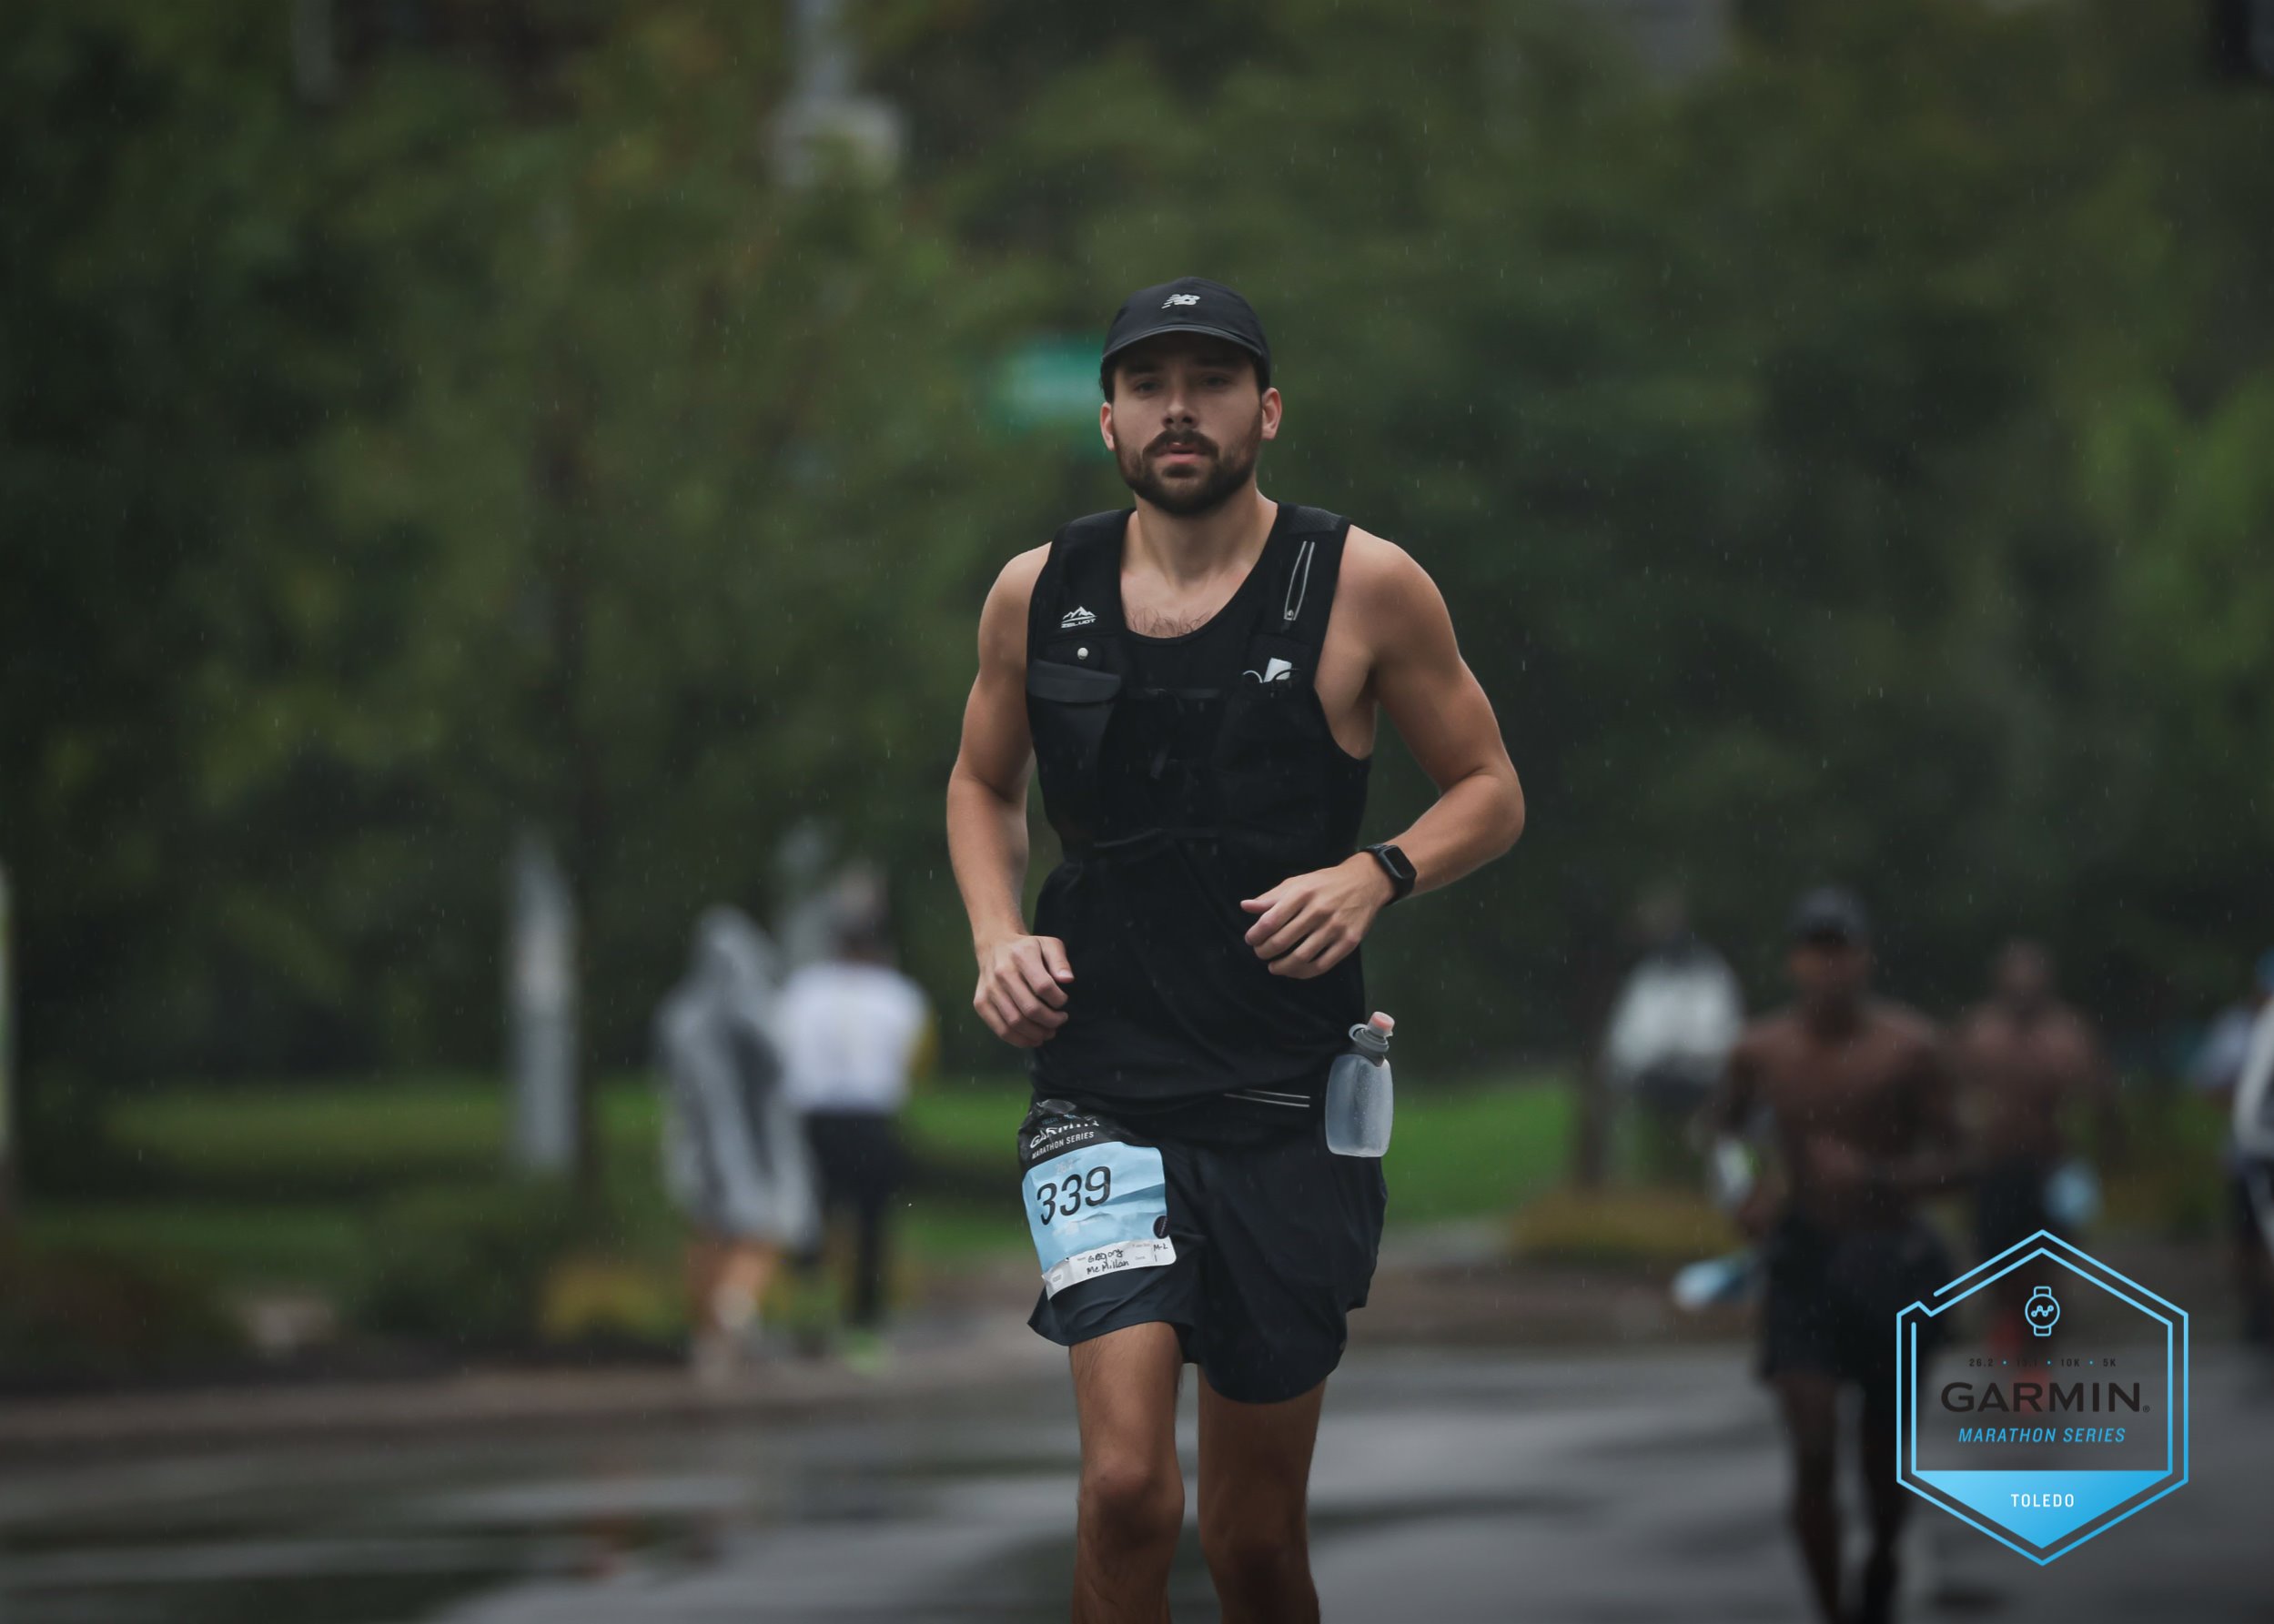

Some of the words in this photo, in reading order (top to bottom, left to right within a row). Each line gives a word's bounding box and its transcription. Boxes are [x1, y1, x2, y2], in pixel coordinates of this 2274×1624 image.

[1032, 1139, 1064, 1160] MARATHON
[1066, 1131, 1095, 1145] SERIES
[1036, 1165, 1111, 1226] 339
